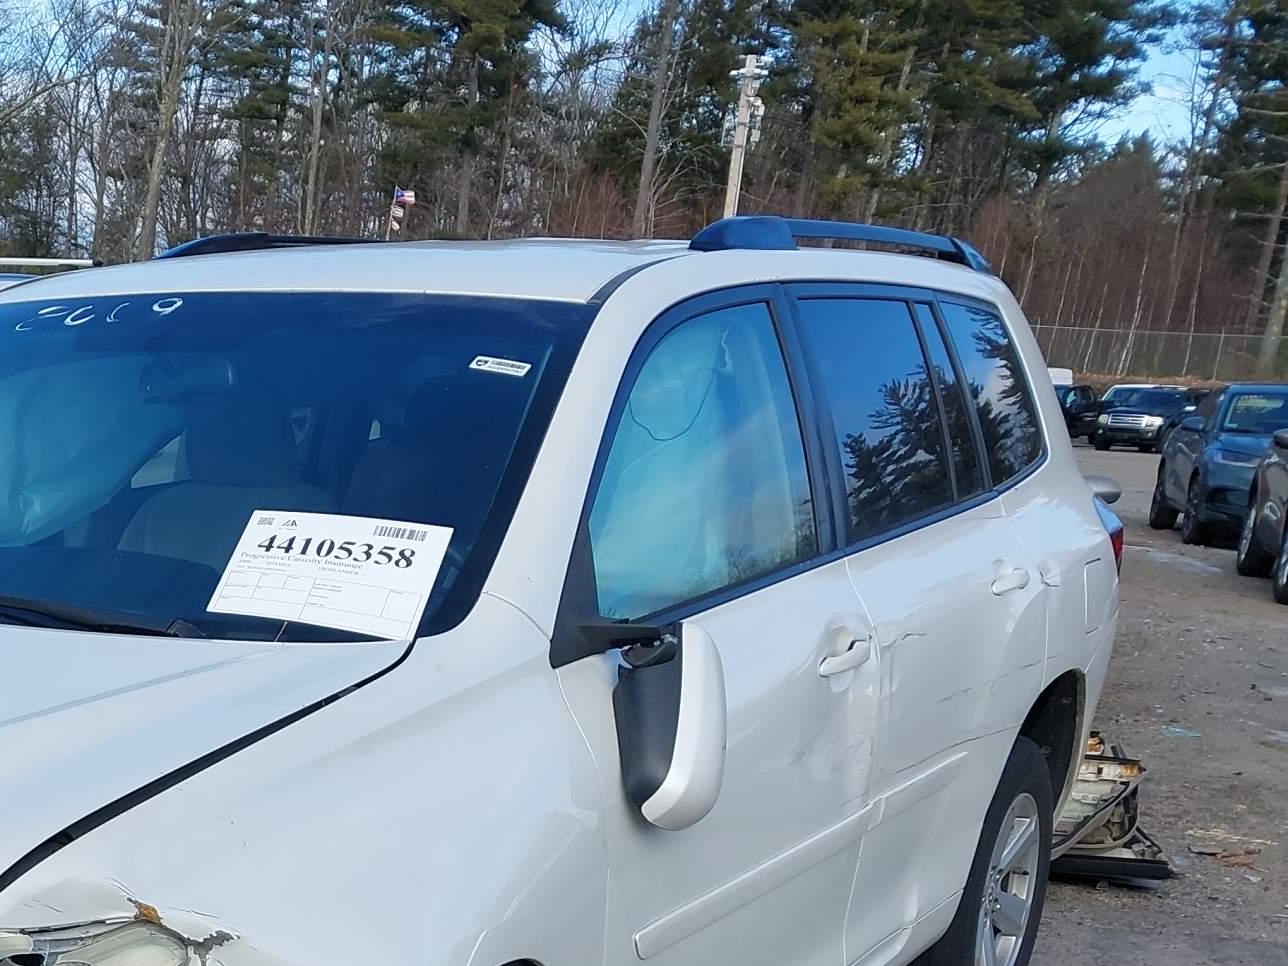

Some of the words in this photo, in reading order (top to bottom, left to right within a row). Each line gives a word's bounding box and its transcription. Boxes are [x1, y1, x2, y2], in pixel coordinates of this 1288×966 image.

[240, 551, 286, 562] Progressive
[287, 555, 321, 565] Casualty
[324, 559, 364, 570] Insurance
[257, 533, 416, 569] 44105358
